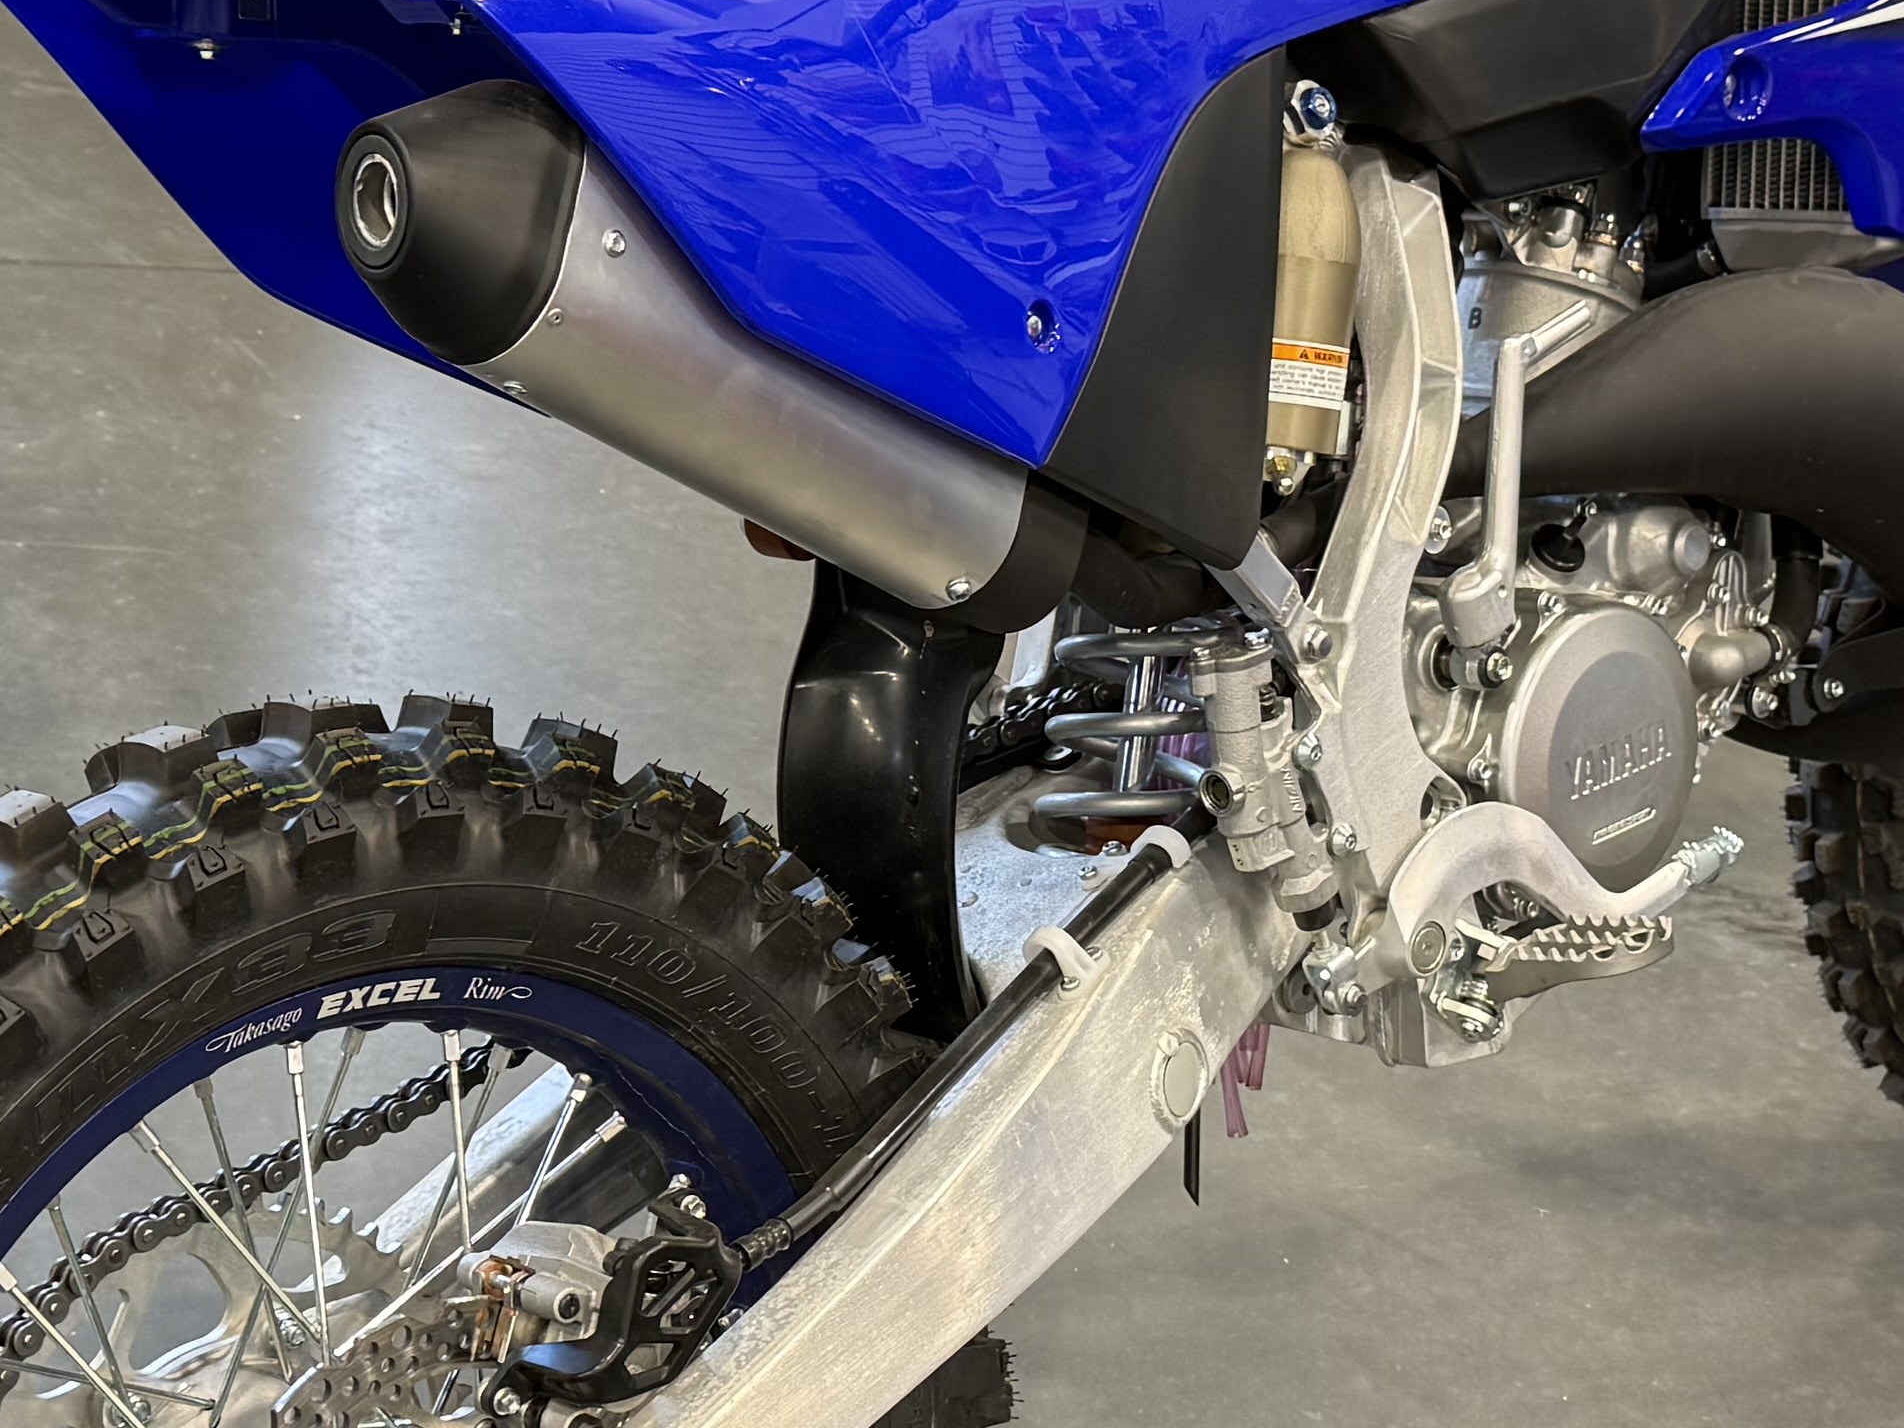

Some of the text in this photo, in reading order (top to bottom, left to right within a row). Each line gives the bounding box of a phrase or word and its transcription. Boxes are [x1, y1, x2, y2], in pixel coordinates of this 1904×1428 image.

[1467, 306, 1483, 330] B
[1563, 719, 1672, 800] YAMAHA
[18, 905, 398, 1147] MX33
[205, 977, 532, 1053] Takasago EXCEL Rim
[574, 918, 858, 1164] 110/100-1
